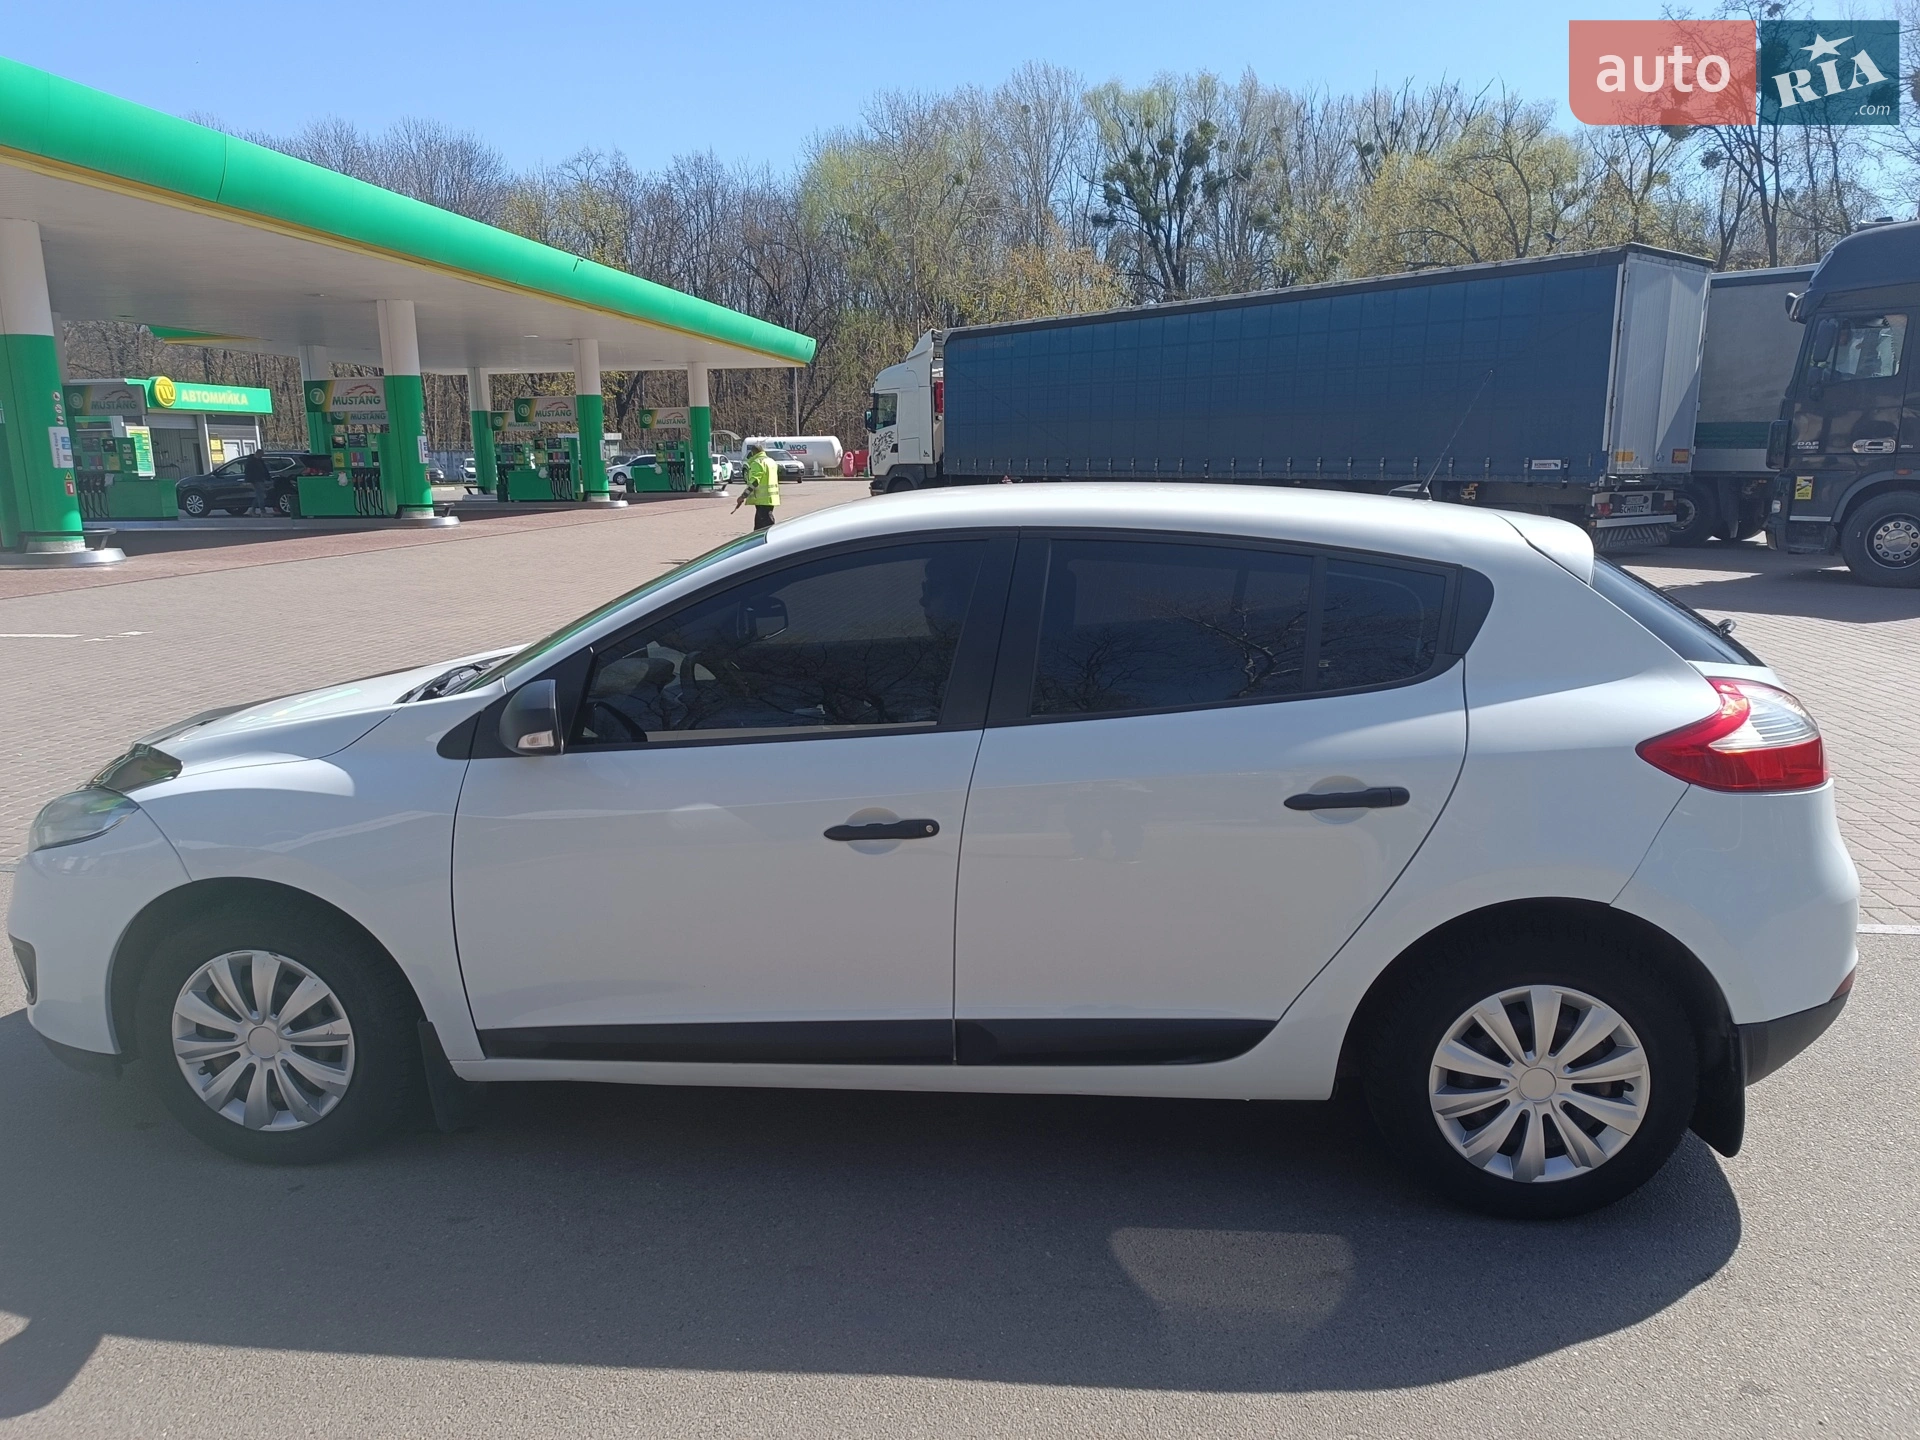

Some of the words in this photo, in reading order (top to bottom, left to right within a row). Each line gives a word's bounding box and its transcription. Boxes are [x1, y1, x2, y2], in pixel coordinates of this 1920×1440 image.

[72, 396, 80, 405] 9
[181, 389, 248, 405] АВТОМИЙКА
[313, 391, 321, 401] 7
[332, 395, 381, 406] MUSTANG
[91, 401, 137, 410] MUSTANG
[350, 412, 387, 420] MUSTANG
[535, 409, 572, 418] MUSTANG
[1609, 540, 1626, 548] LONG
